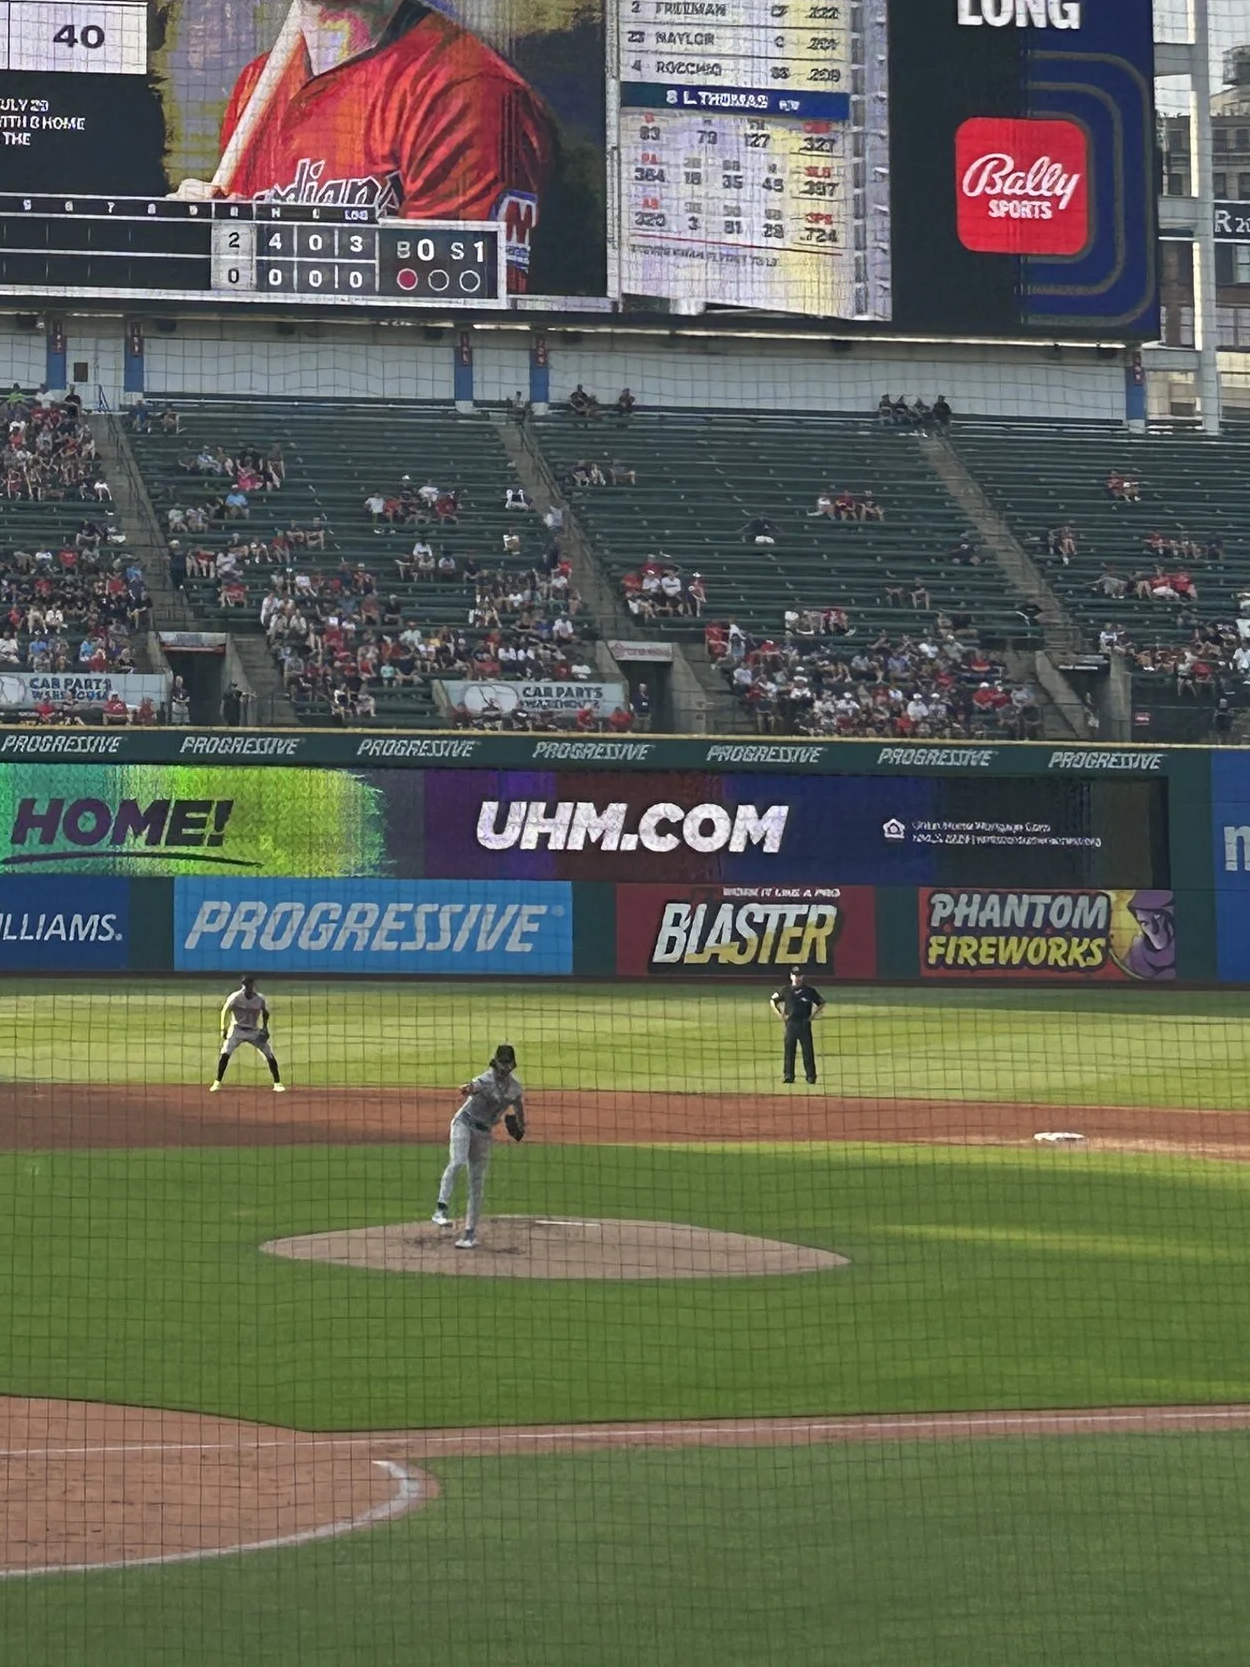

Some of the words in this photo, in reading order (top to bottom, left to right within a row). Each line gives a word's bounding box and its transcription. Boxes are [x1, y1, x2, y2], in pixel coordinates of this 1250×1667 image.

[52, 25, 106, 50] 40
[666, 89, 678, 105] 8
[43, 117, 86, 131] HOME
[2, 132, 31, 146] THE
[961, 151, 1081, 210] Bally
[987, 199, 1054, 221] SPORTS
[228, 232, 241, 249] 2
[268, 233, 283, 250] 4
[308, 235, 323, 251] 0
[350, 236, 364, 253] 3
[417, 238, 436, 262] 0
[450, 243, 466, 261] S
[474, 241, 485, 263] 1
[228, 268, 240, 284] 0
[268, 268, 283, 286] 0
[308, 270, 323, 287] 0
[350, 271, 364, 288] 0
[556, 686, 603, 699] PARTS
[0, 734, 122, 754] PROGRESSIVE
[179, 736, 299, 755] PROGRESSIVE
[356, 738, 475, 758] PROGRESSIVE
[532, 741, 650, 761] PROGRESSIVE
[707, 744, 822, 764] PROGRESSIVE
[877, 747, 992, 767] PROGRESSIVE
[1048, 750, 1162, 770] PROGRESSIVE
[10, 797, 234, 848] HOME!
[476, 800, 789, 853] UHM.COM
[929, 893, 1108, 931] PHANTOM
[184, 900, 550, 953] PROGRESSIVE
[651, 901, 838, 966] BLASTER
[928, 936, 1106, 971] FIREWORKS
